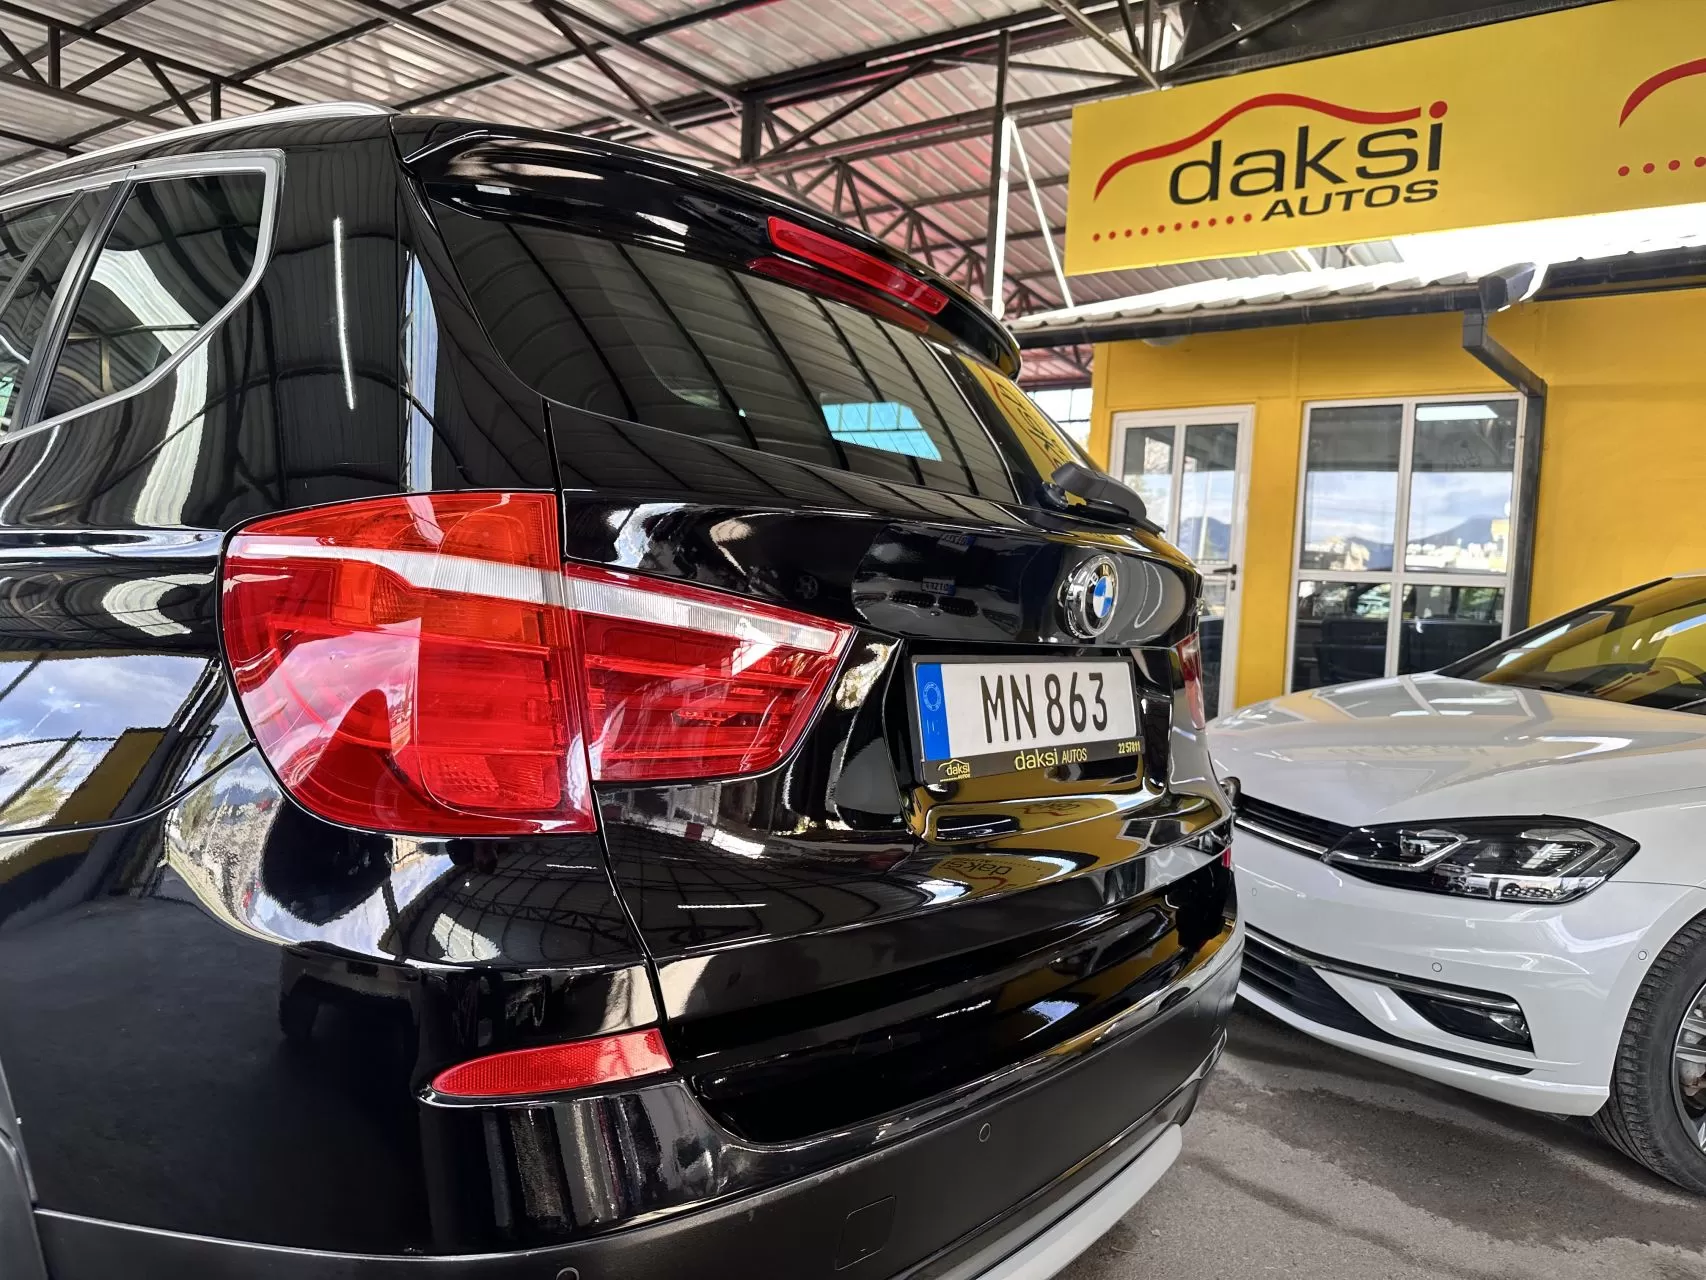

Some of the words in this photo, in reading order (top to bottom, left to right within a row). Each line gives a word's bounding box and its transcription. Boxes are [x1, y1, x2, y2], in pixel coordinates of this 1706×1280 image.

[1169, 101, 1447, 205] daksi
[1261, 179, 1439, 221] AUTOS
[980, 674, 1037, 743] MN
[1044, 672, 1108, 736] 863
[946, 762, 970, 776] daksi
[1014, 748, 1059, 770] daksi
[1061, 747, 1088, 764] AUTOS
